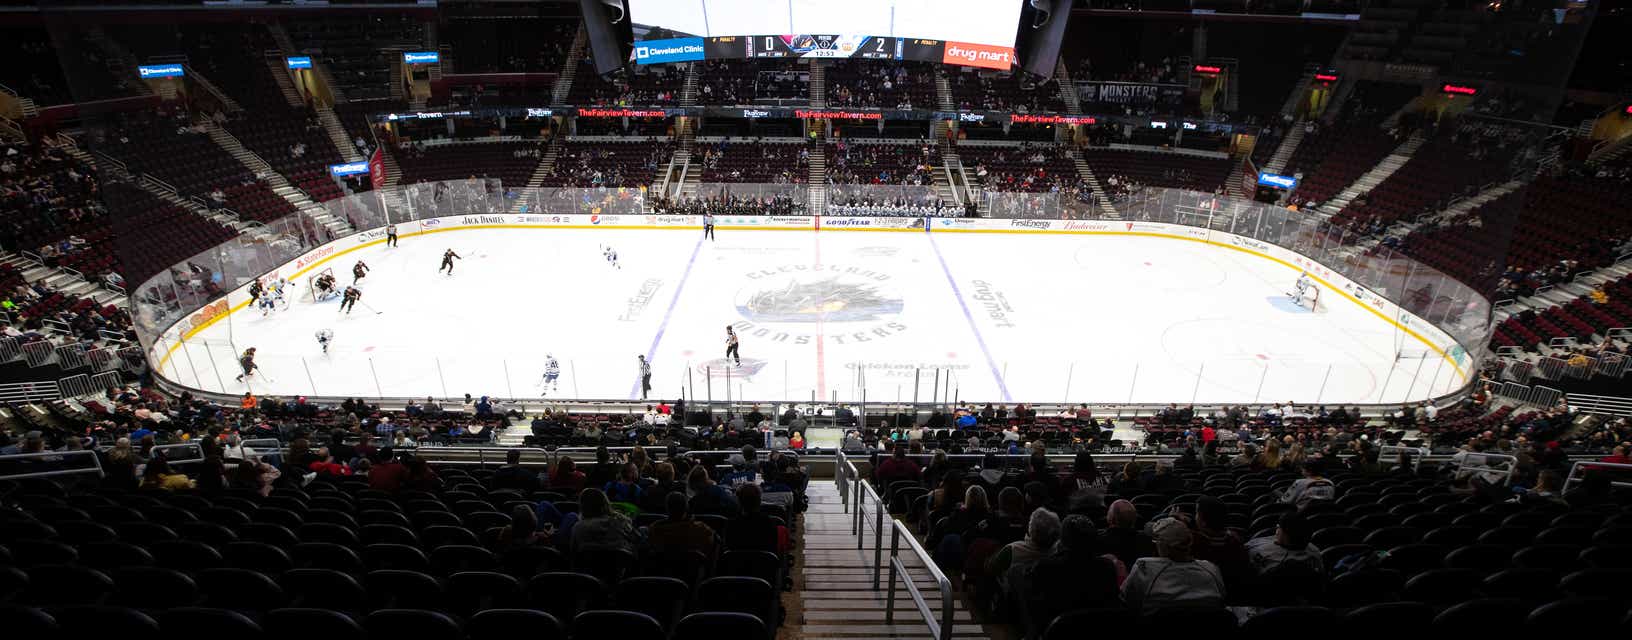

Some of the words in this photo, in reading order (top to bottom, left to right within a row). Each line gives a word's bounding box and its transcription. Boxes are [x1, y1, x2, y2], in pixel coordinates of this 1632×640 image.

[766, 37, 774, 51] 0
[876, 37, 885, 52] 2
[649, 46, 683, 56] Cleveland
[683, 45, 704, 54] Clinic
[948, 46, 977, 61] drug
[978, 51, 1009, 63] mart
[1099, 84, 1158, 102] MONSTERS
[416, 111, 443, 119] Tavern
[578, 108, 665, 118] TheFairviewTavern.com
[794, 109, 882, 120] TheFairviewTavern.com
[1010, 113, 1095, 125] TheFairviewTavern.com
[462, 216, 478, 225] JACK
[826, 217, 871, 226] GOODYEAR
[1010, 219, 1052, 230] FirstEnergy
[1063, 221, 1109, 231] Budweiser
[745, 264, 892, 281] CLEVELAND
[733, 320, 908, 346] MONSTERS
